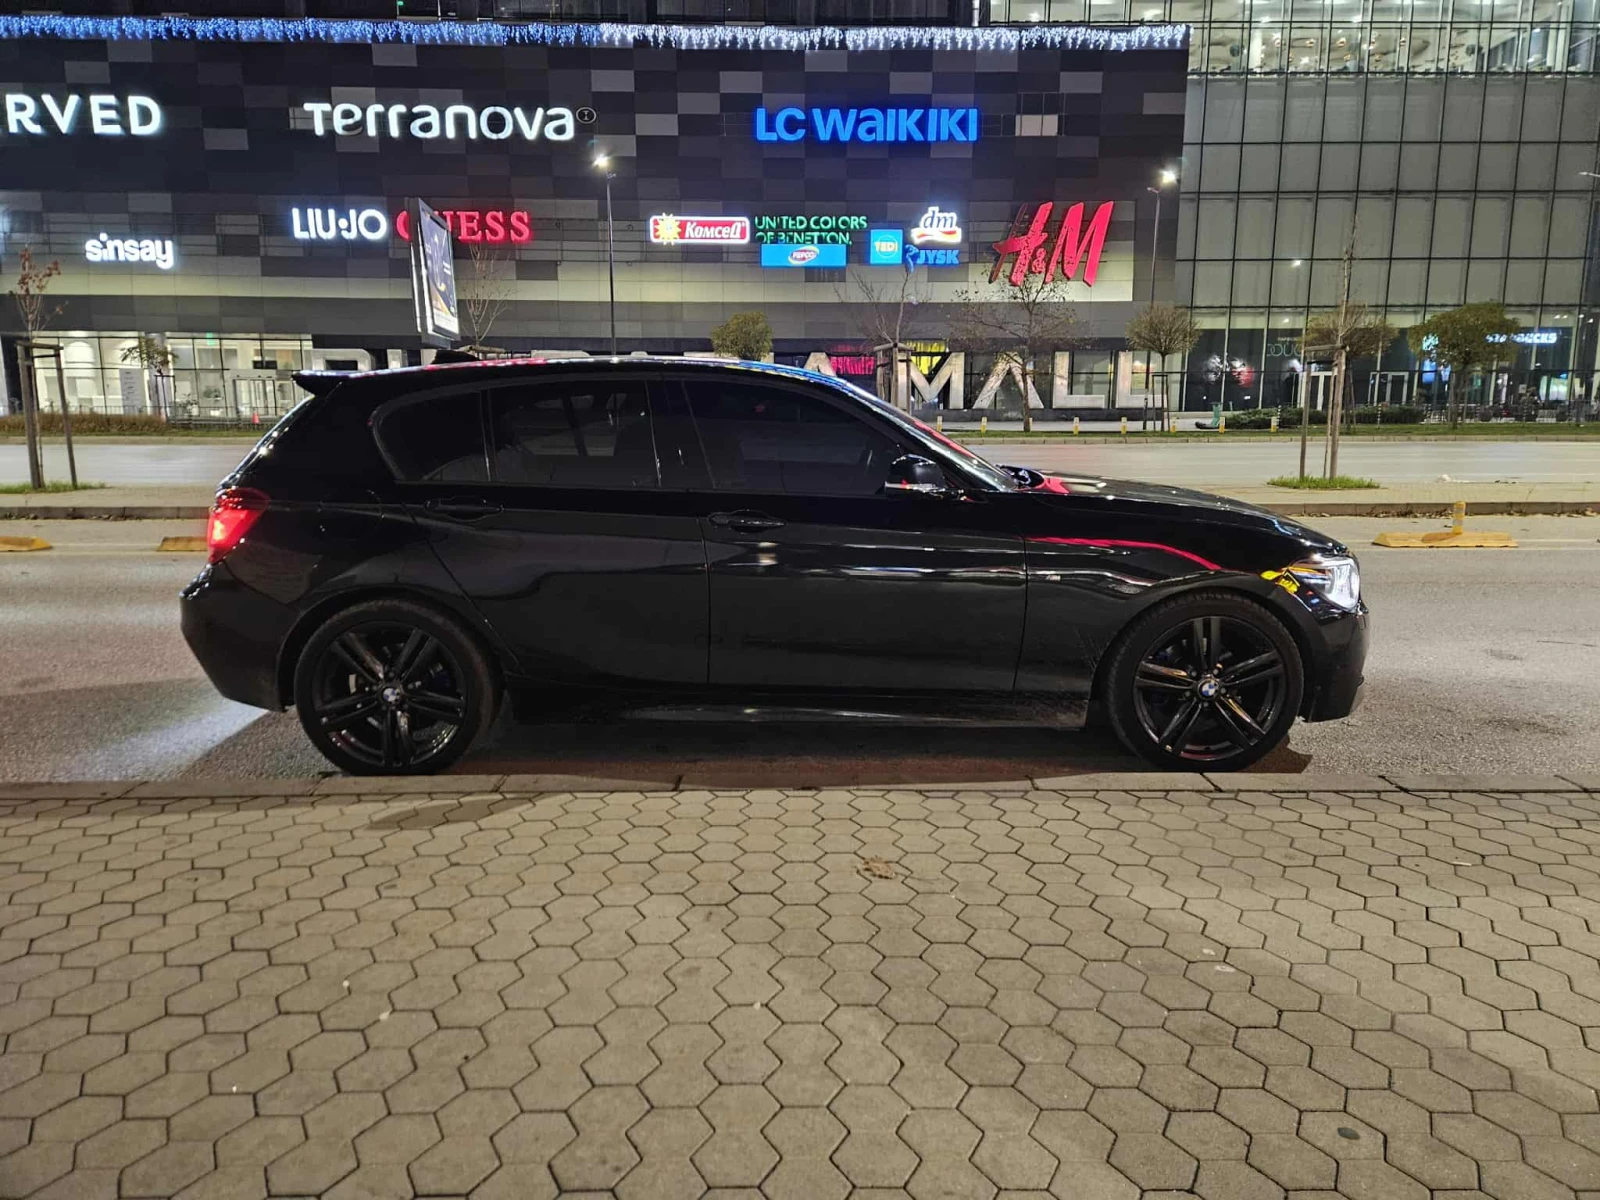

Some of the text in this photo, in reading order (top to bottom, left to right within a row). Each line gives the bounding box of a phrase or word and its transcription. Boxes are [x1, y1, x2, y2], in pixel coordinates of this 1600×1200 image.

[756, 107, 806, 141] LC
[754, 215, 868, 229] UNITED COLORS
[923, 209, 955, 229] dm
[85, 232, 174, 270] sinsay
[755, 231, 775, 244] OF
[988, 200, 1114, 287] H&M
[916, 249, 960, 265] JYSK
[896, 350, 1168, 410] MALL
